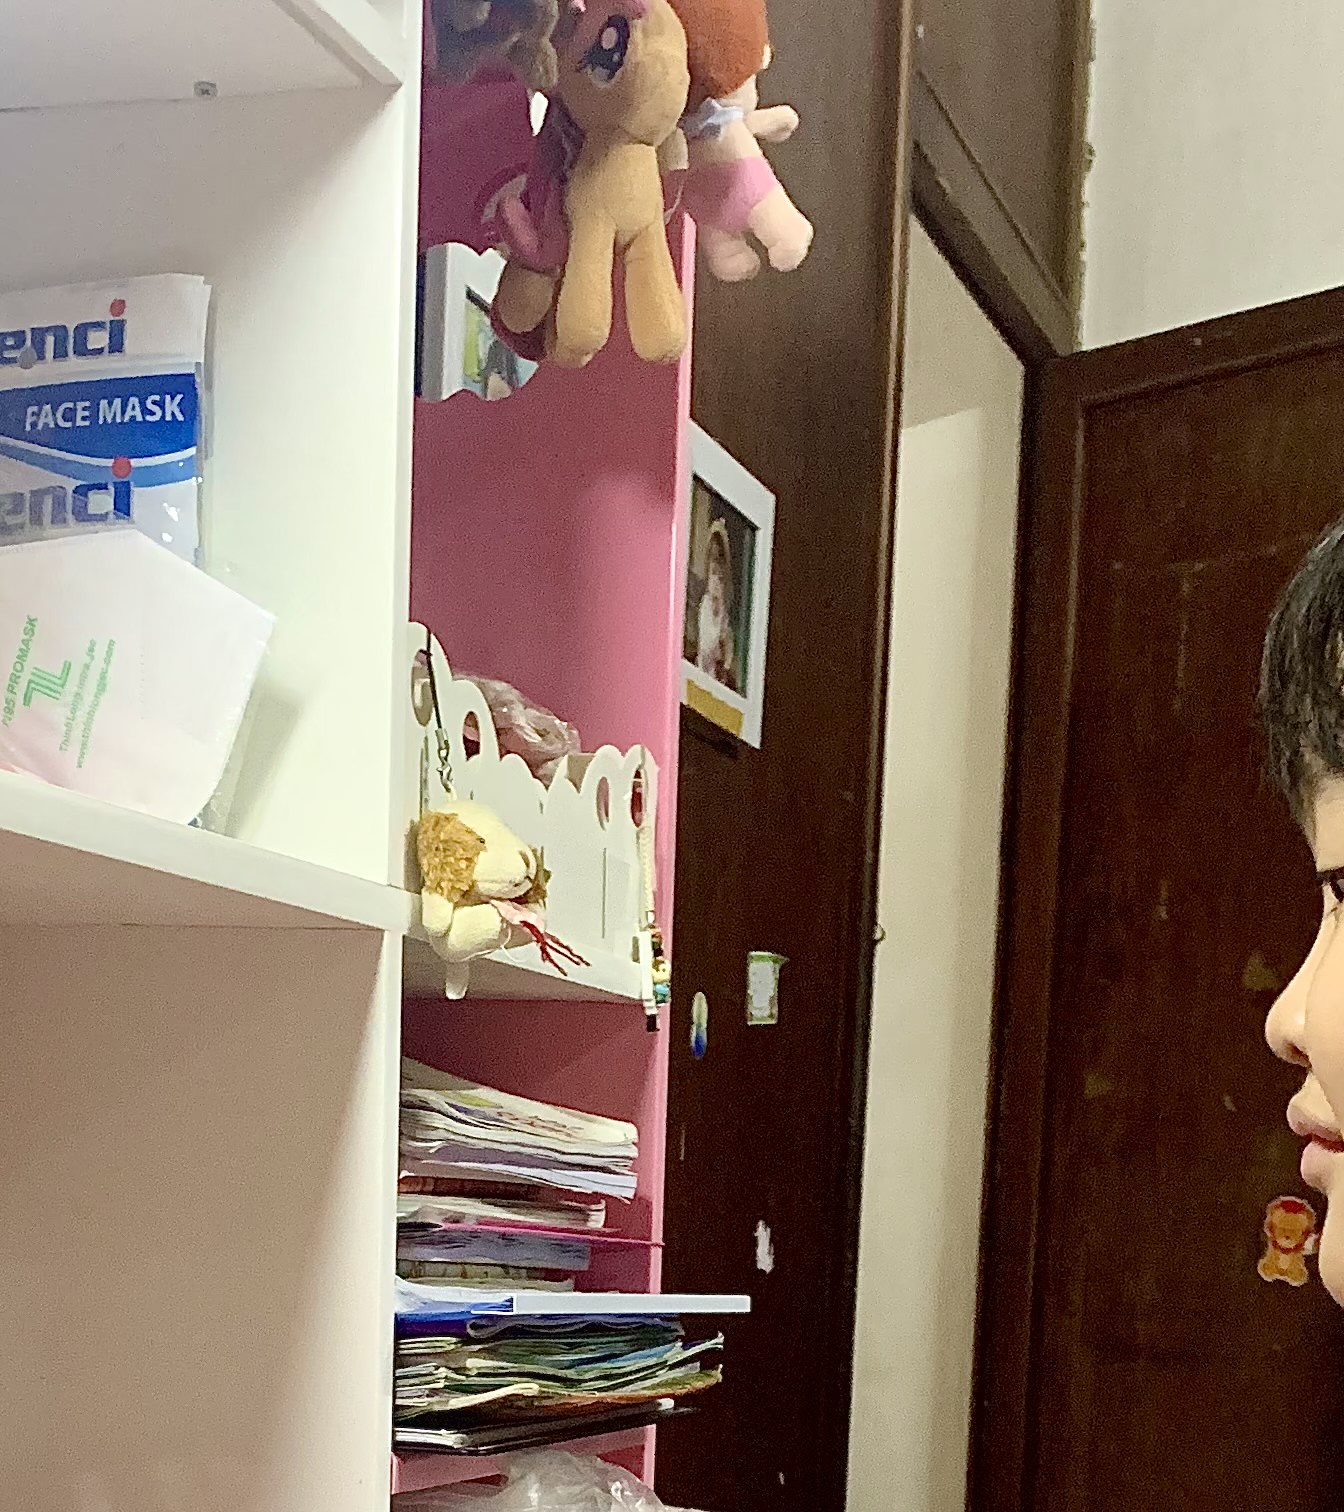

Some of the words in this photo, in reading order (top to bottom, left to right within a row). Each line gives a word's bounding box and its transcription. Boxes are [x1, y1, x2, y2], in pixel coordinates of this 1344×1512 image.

[25, 401, 91, 432] FACE
[98, 393, 185, 425] MASK
[6, 614, 39, 696] PROMASK
